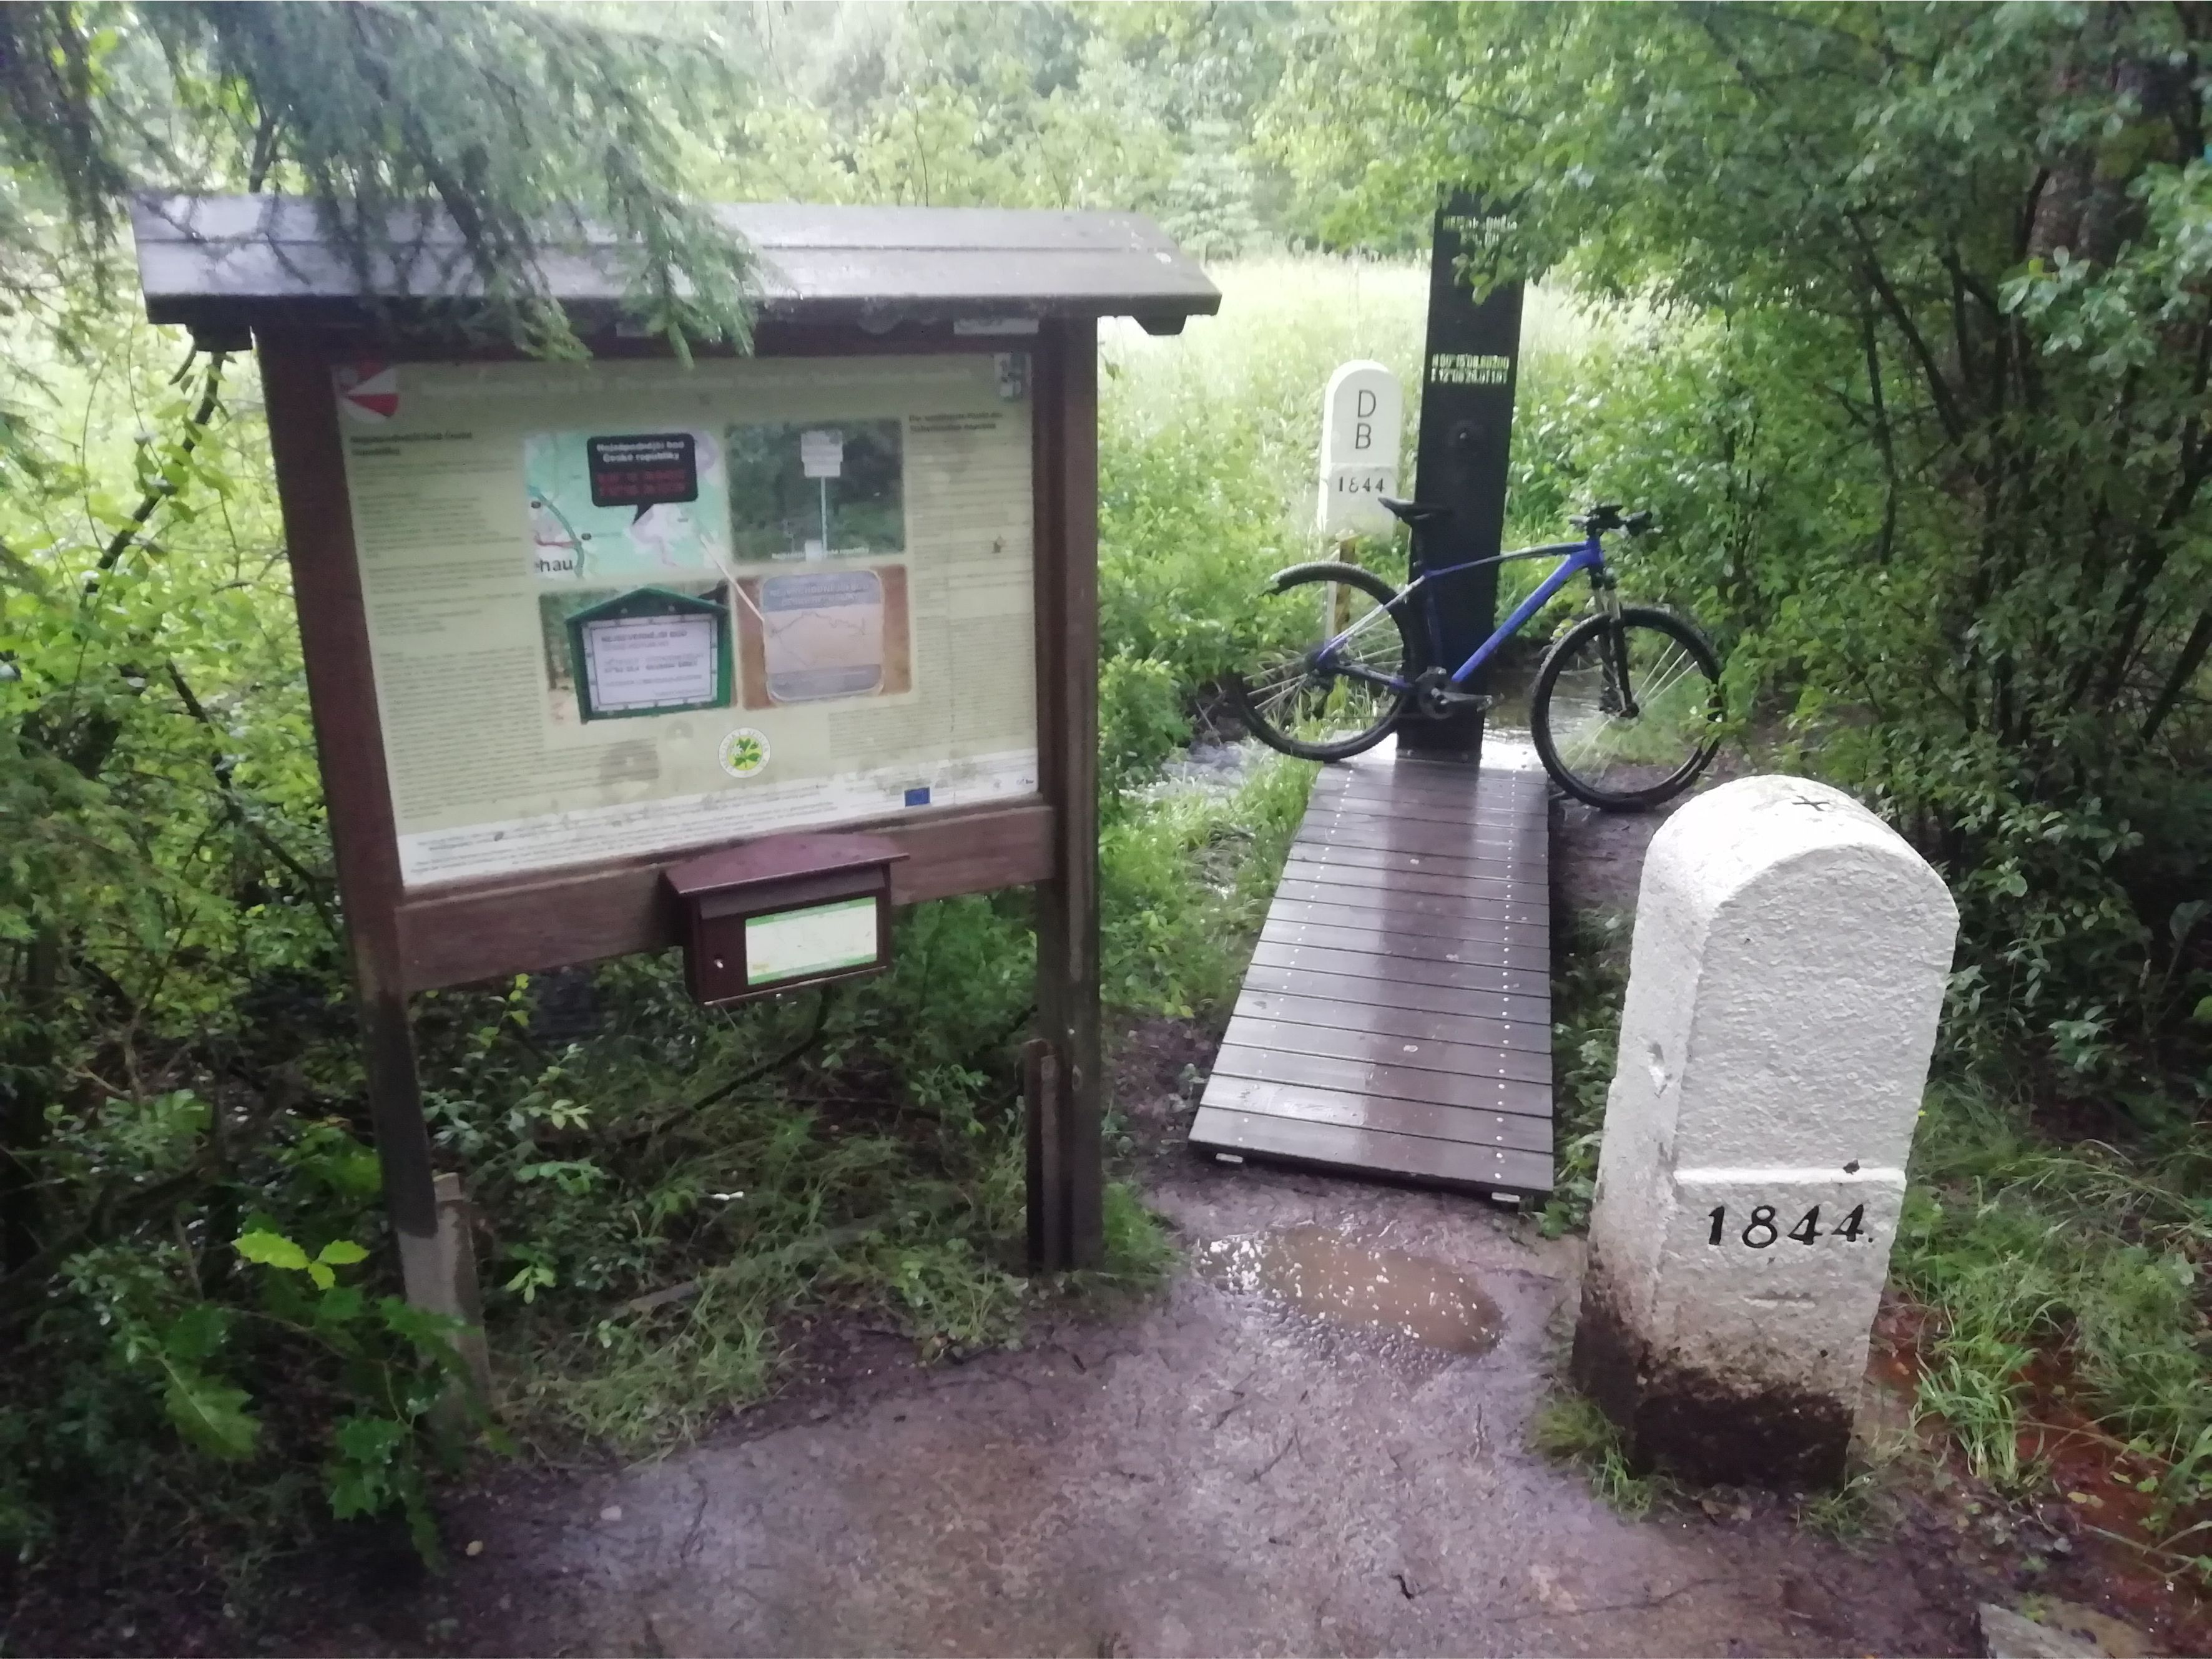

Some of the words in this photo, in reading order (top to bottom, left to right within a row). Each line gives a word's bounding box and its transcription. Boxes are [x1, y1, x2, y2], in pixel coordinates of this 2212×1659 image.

[1357, 389, 1377, 418] D
[1355, 422, 1372, 449] B
[1339, 475, 1385, 494] 1844
